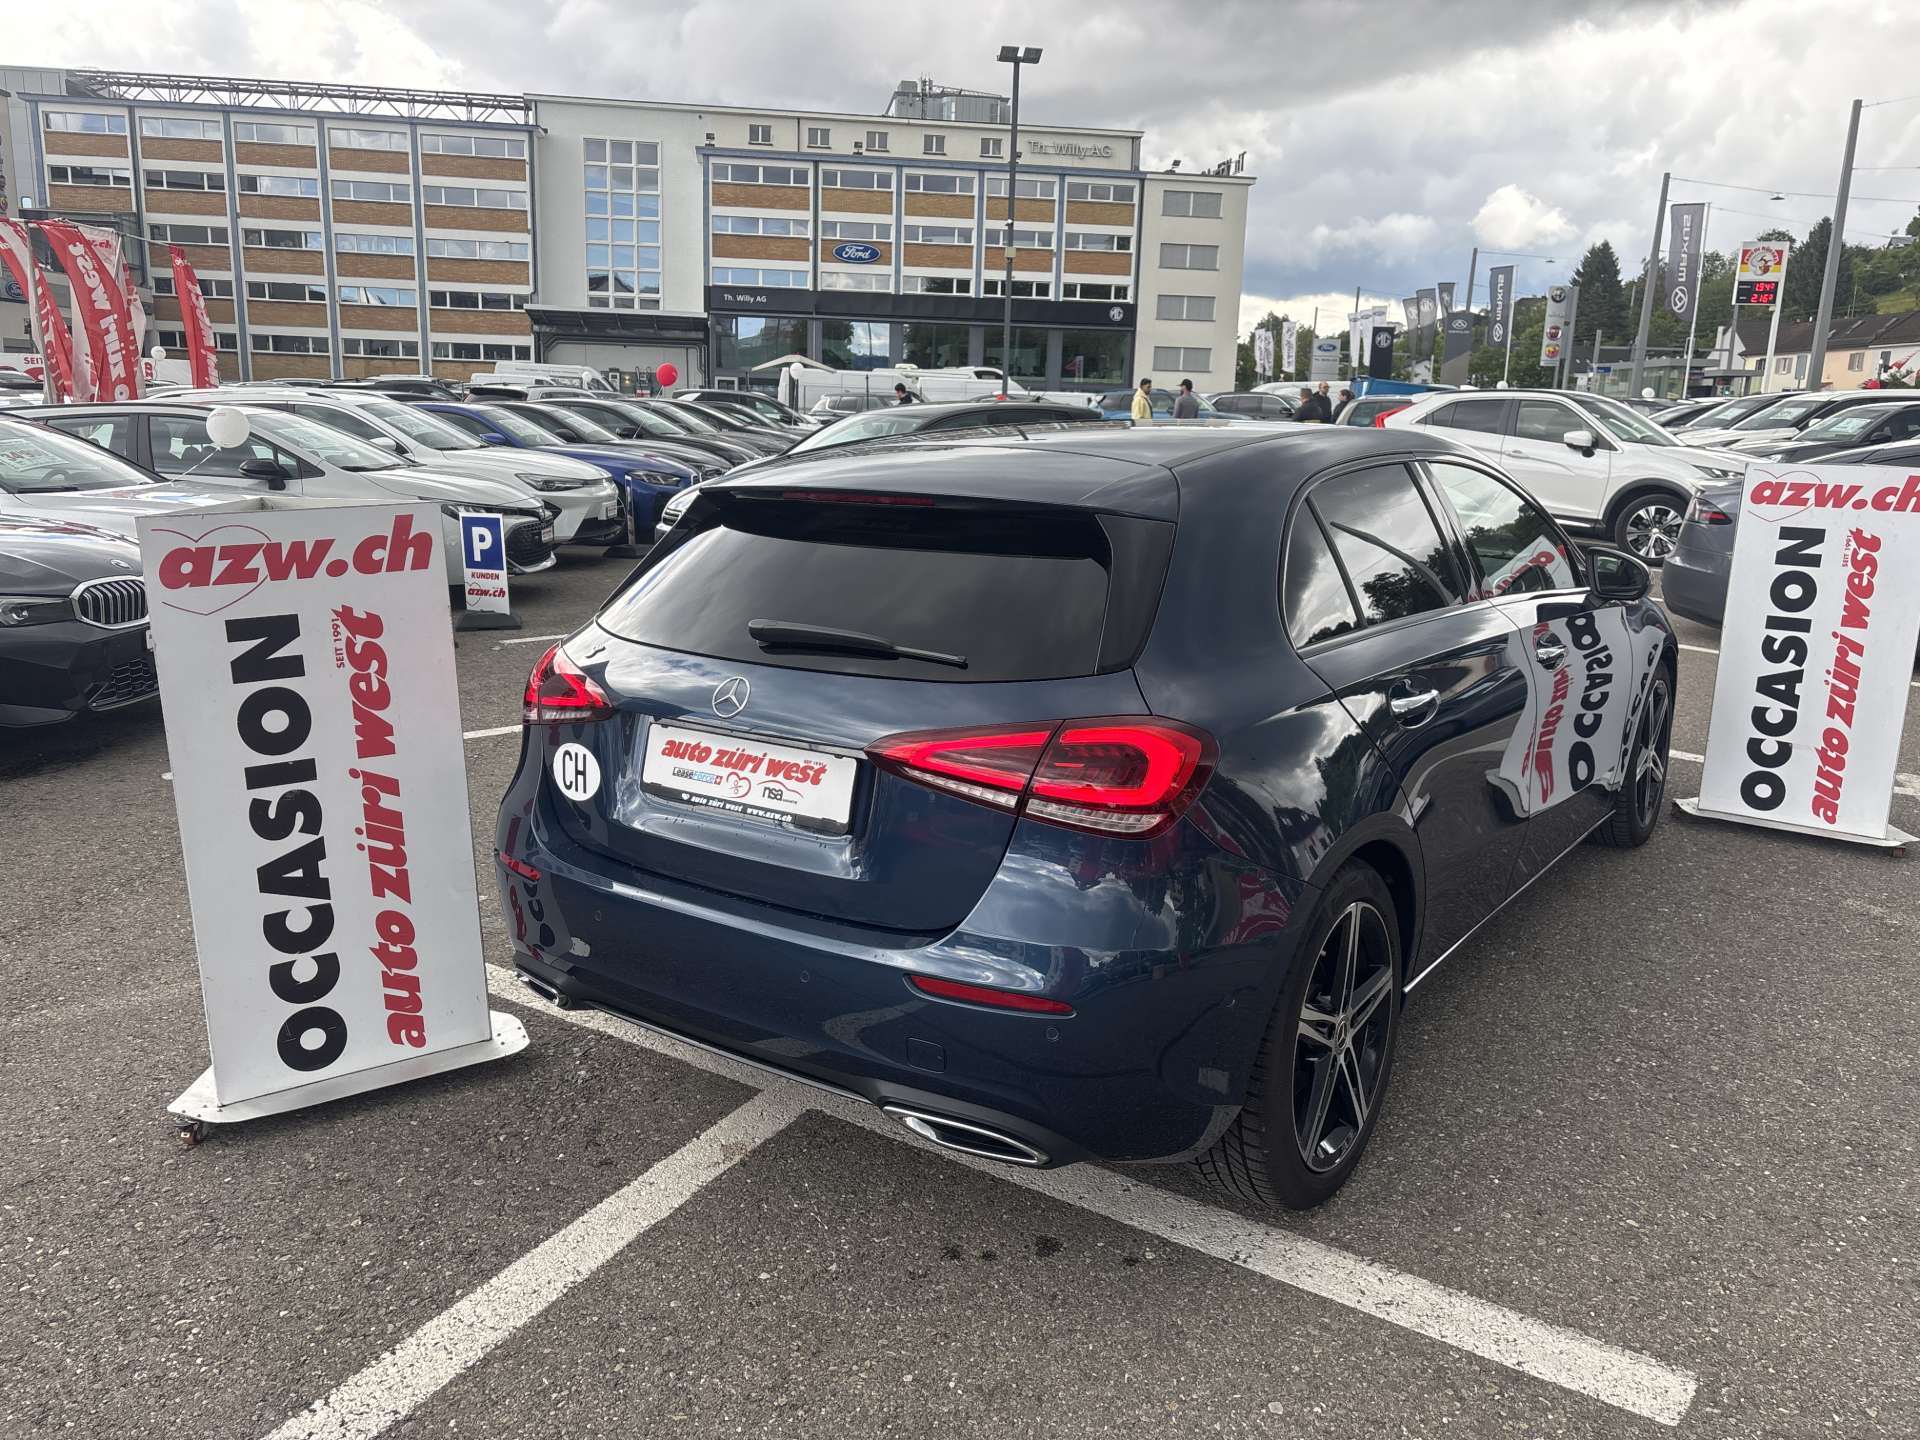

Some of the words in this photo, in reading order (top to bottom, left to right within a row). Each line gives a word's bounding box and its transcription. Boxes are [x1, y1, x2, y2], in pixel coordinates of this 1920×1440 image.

[1055, 143, 1087, 159] Willy
[1092, 145, 1112, 157] AG
[736, 294, 754, 303] Willy
[756, 295, 767, 303] AG
[1375, 331, 1392, 348] MG
[1750, 475, 1920, 513] azw.ch
[159, 514, 433, 590] azw.ch
[471, 526, 493, 562] P
[467, 586, 506, 598] azw.ch
[471, 571, 500, 580] KUNDEN
[1840, 527, 1881, 629] west
[331, 618, 342, 643] 1991
[335, 646, 345, 668] SEIT
[1740, 526, 1826, 811] OCCASION
[331, 604, 396, 759] west
[1824, 631, 1864, 728] züri
[562, 749, 587, 794] CH
[661, 738, 713, 764] auto
[710, 747, 767, 775] züri
[765, 757, 828, 785] west
[1812, 727, 1849, 825] auto
[690, 795, 708, 805] auto
[707, 799, 725, 809] züri
[725, 803, 743, 813] west
[762, 786, 783, 801] nsa
[224, 613, 347, 1072] OCCASION
[348, 767, 412, 905] züri
[368, 910, 427, 1048] auto
